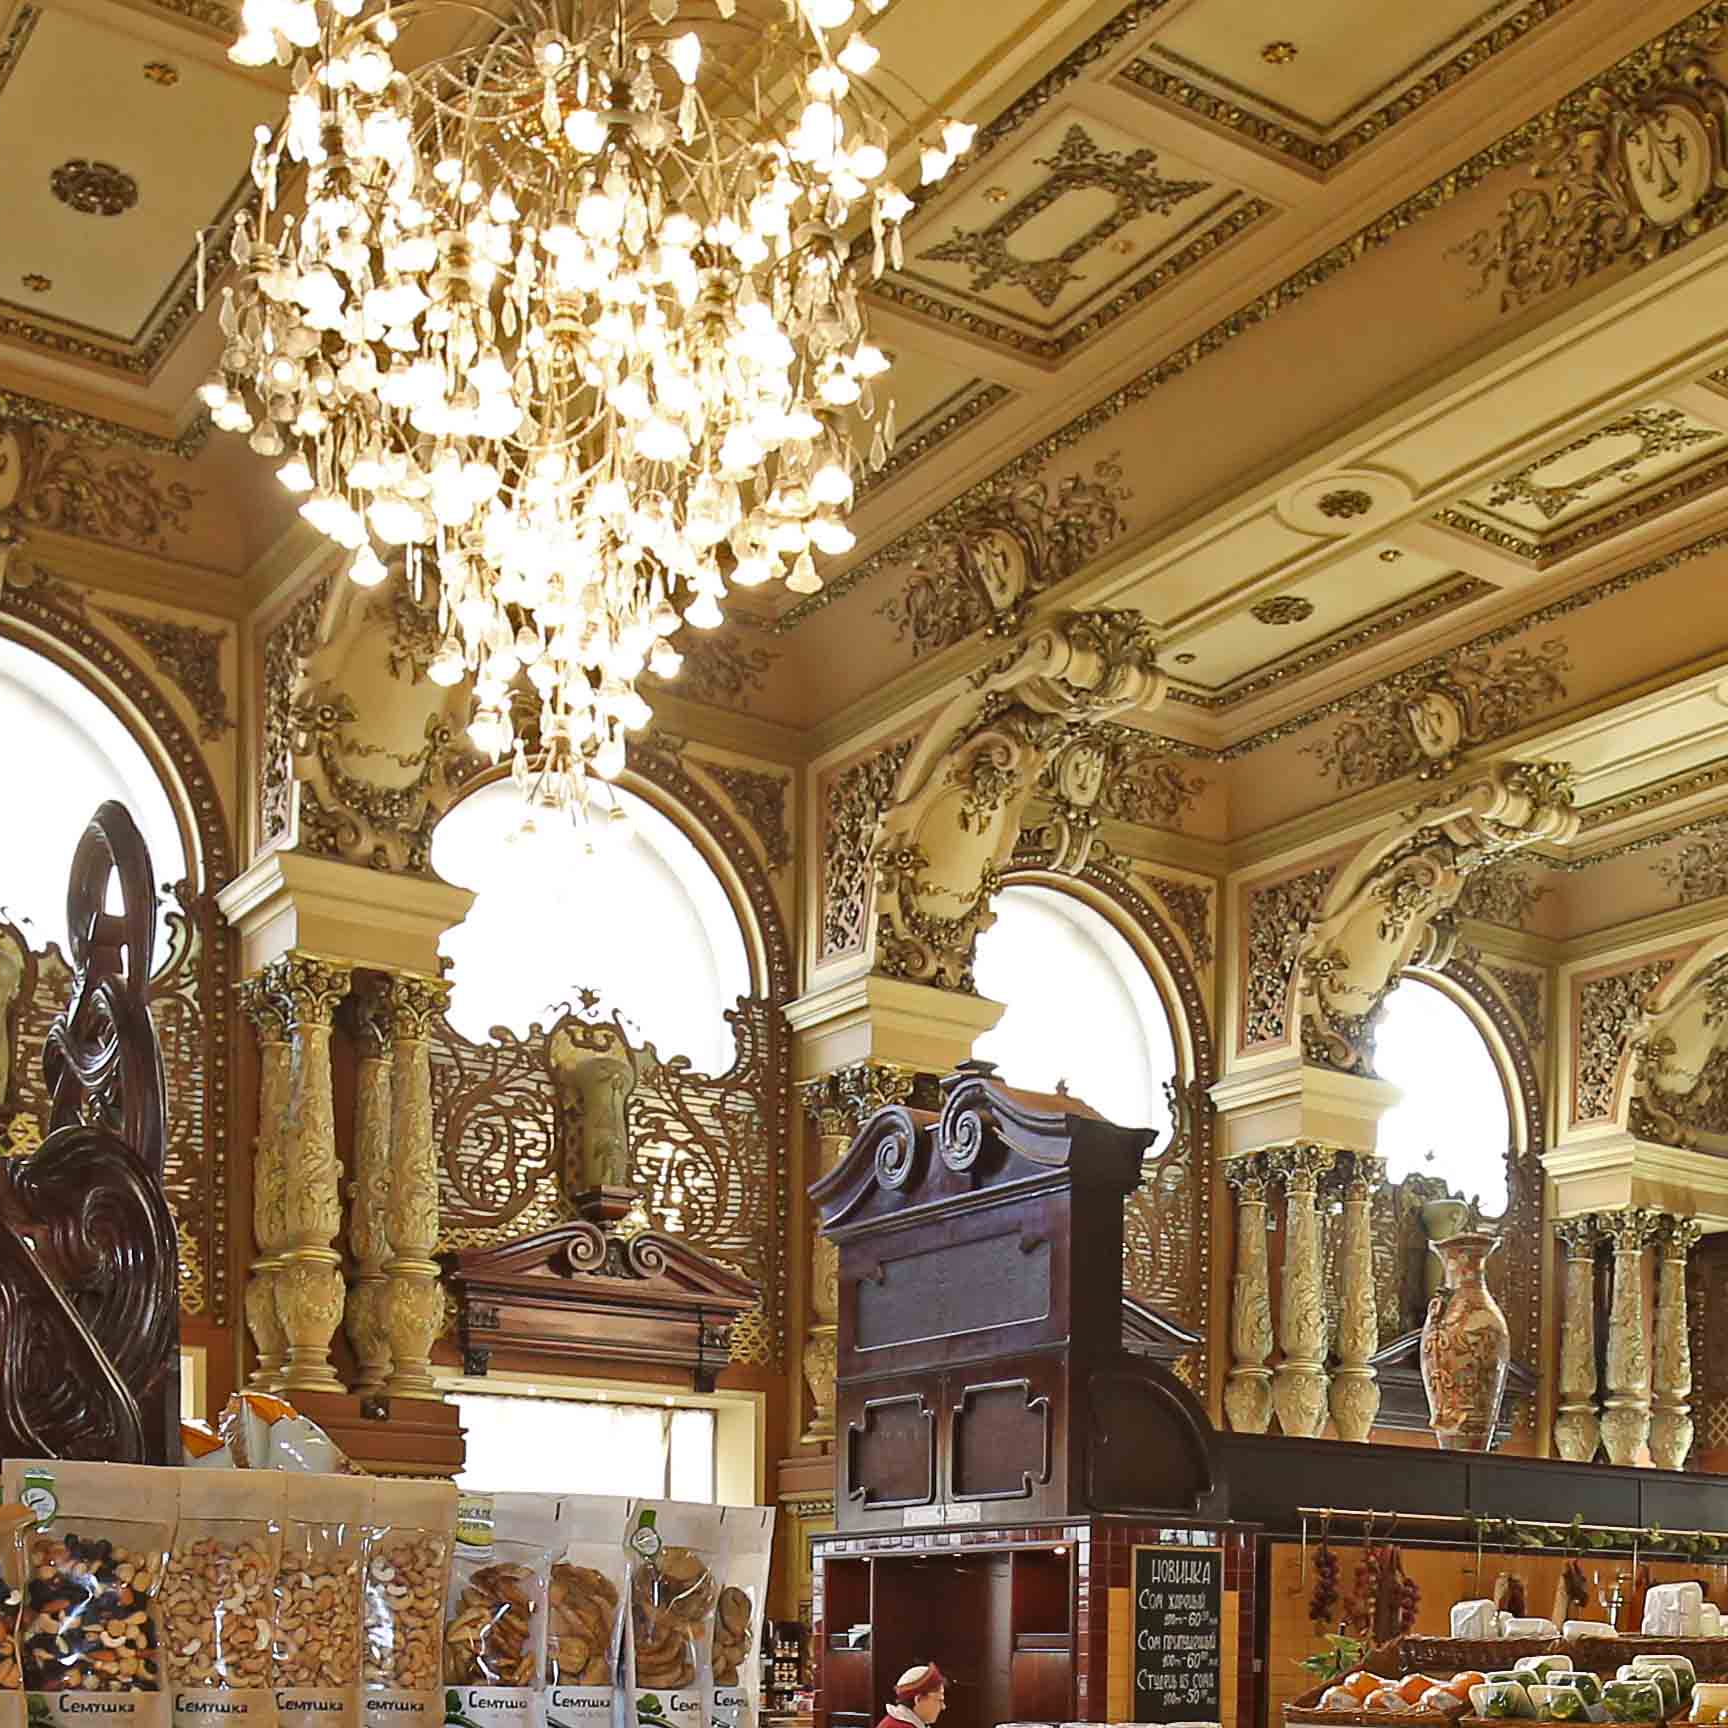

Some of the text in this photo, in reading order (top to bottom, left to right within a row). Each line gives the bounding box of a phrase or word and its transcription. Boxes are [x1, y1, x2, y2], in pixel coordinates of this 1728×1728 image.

[59, 1694, 135, 1713] Семушка
[175, 1694, 248, 1713] Семушка
[275, 1692, 343, 1711] Семушка
[367, 1699, 425, 1711] емушка
[468, 1691, 528, 1709] Семуш
